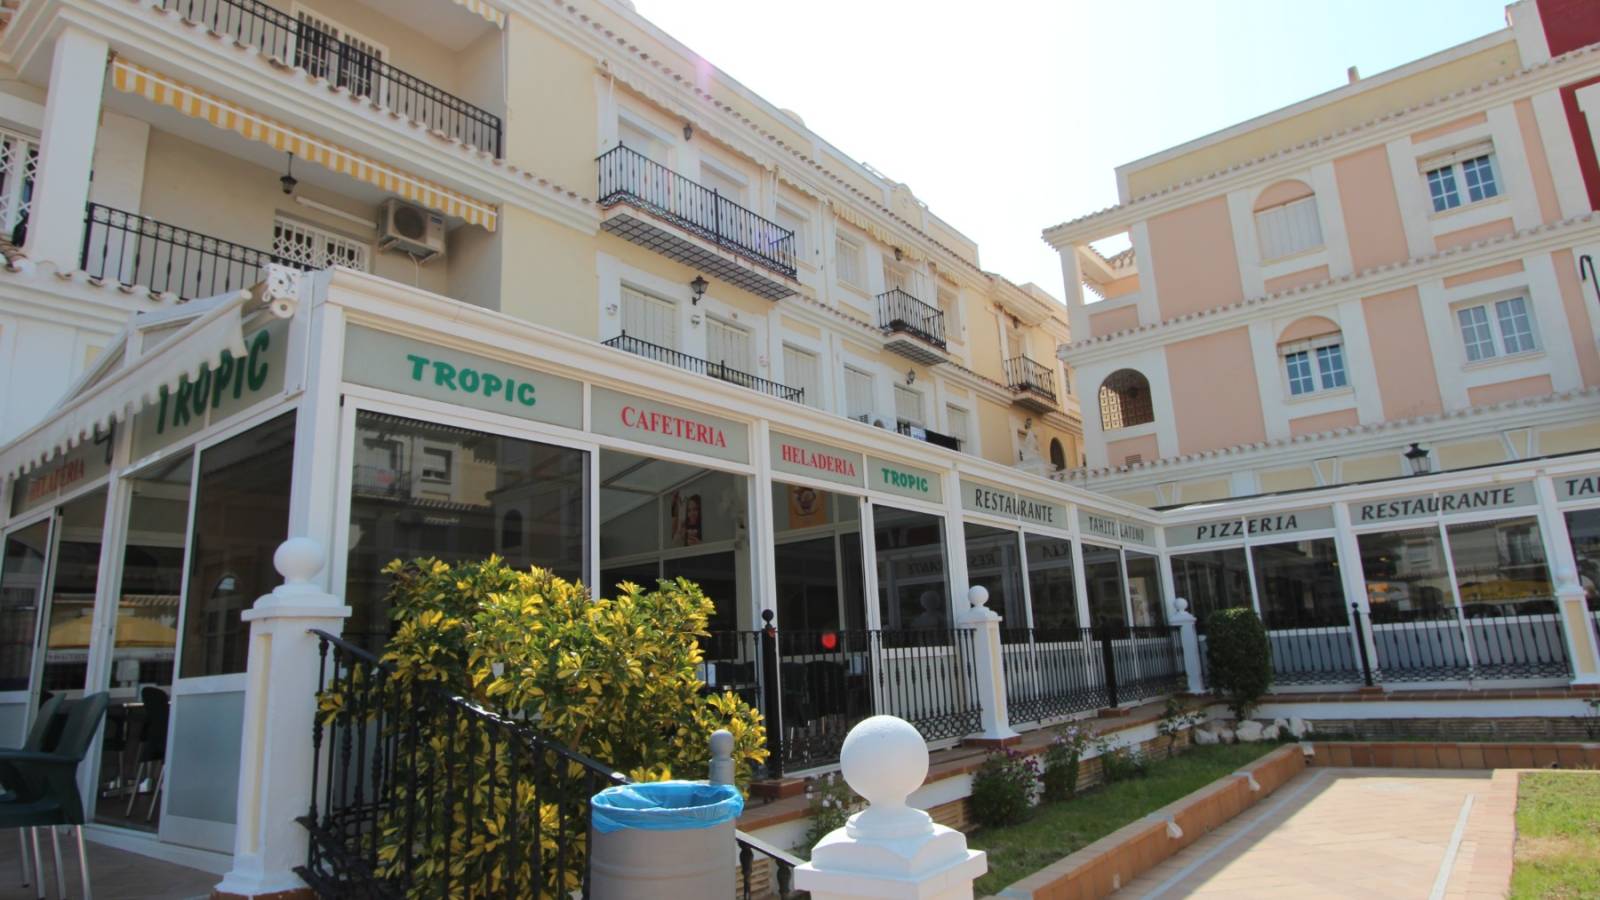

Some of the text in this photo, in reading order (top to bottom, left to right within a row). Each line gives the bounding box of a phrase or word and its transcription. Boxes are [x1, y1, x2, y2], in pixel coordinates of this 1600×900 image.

[407, 354, 537, 406] TROPIC
[620, 405, 727, 448] CAFETERIA
[782, 443, 856, 477] HELADERIA
[881, 467, 929, 493] TROPIC
[1565, 476, 1600, 496] TA
[975, 488, 1054, 523] RESTAURANTE
[1361, 486, 1516, 521] RESTAURANTE
[1197, 514, 1298, 540] PIZZERIA
